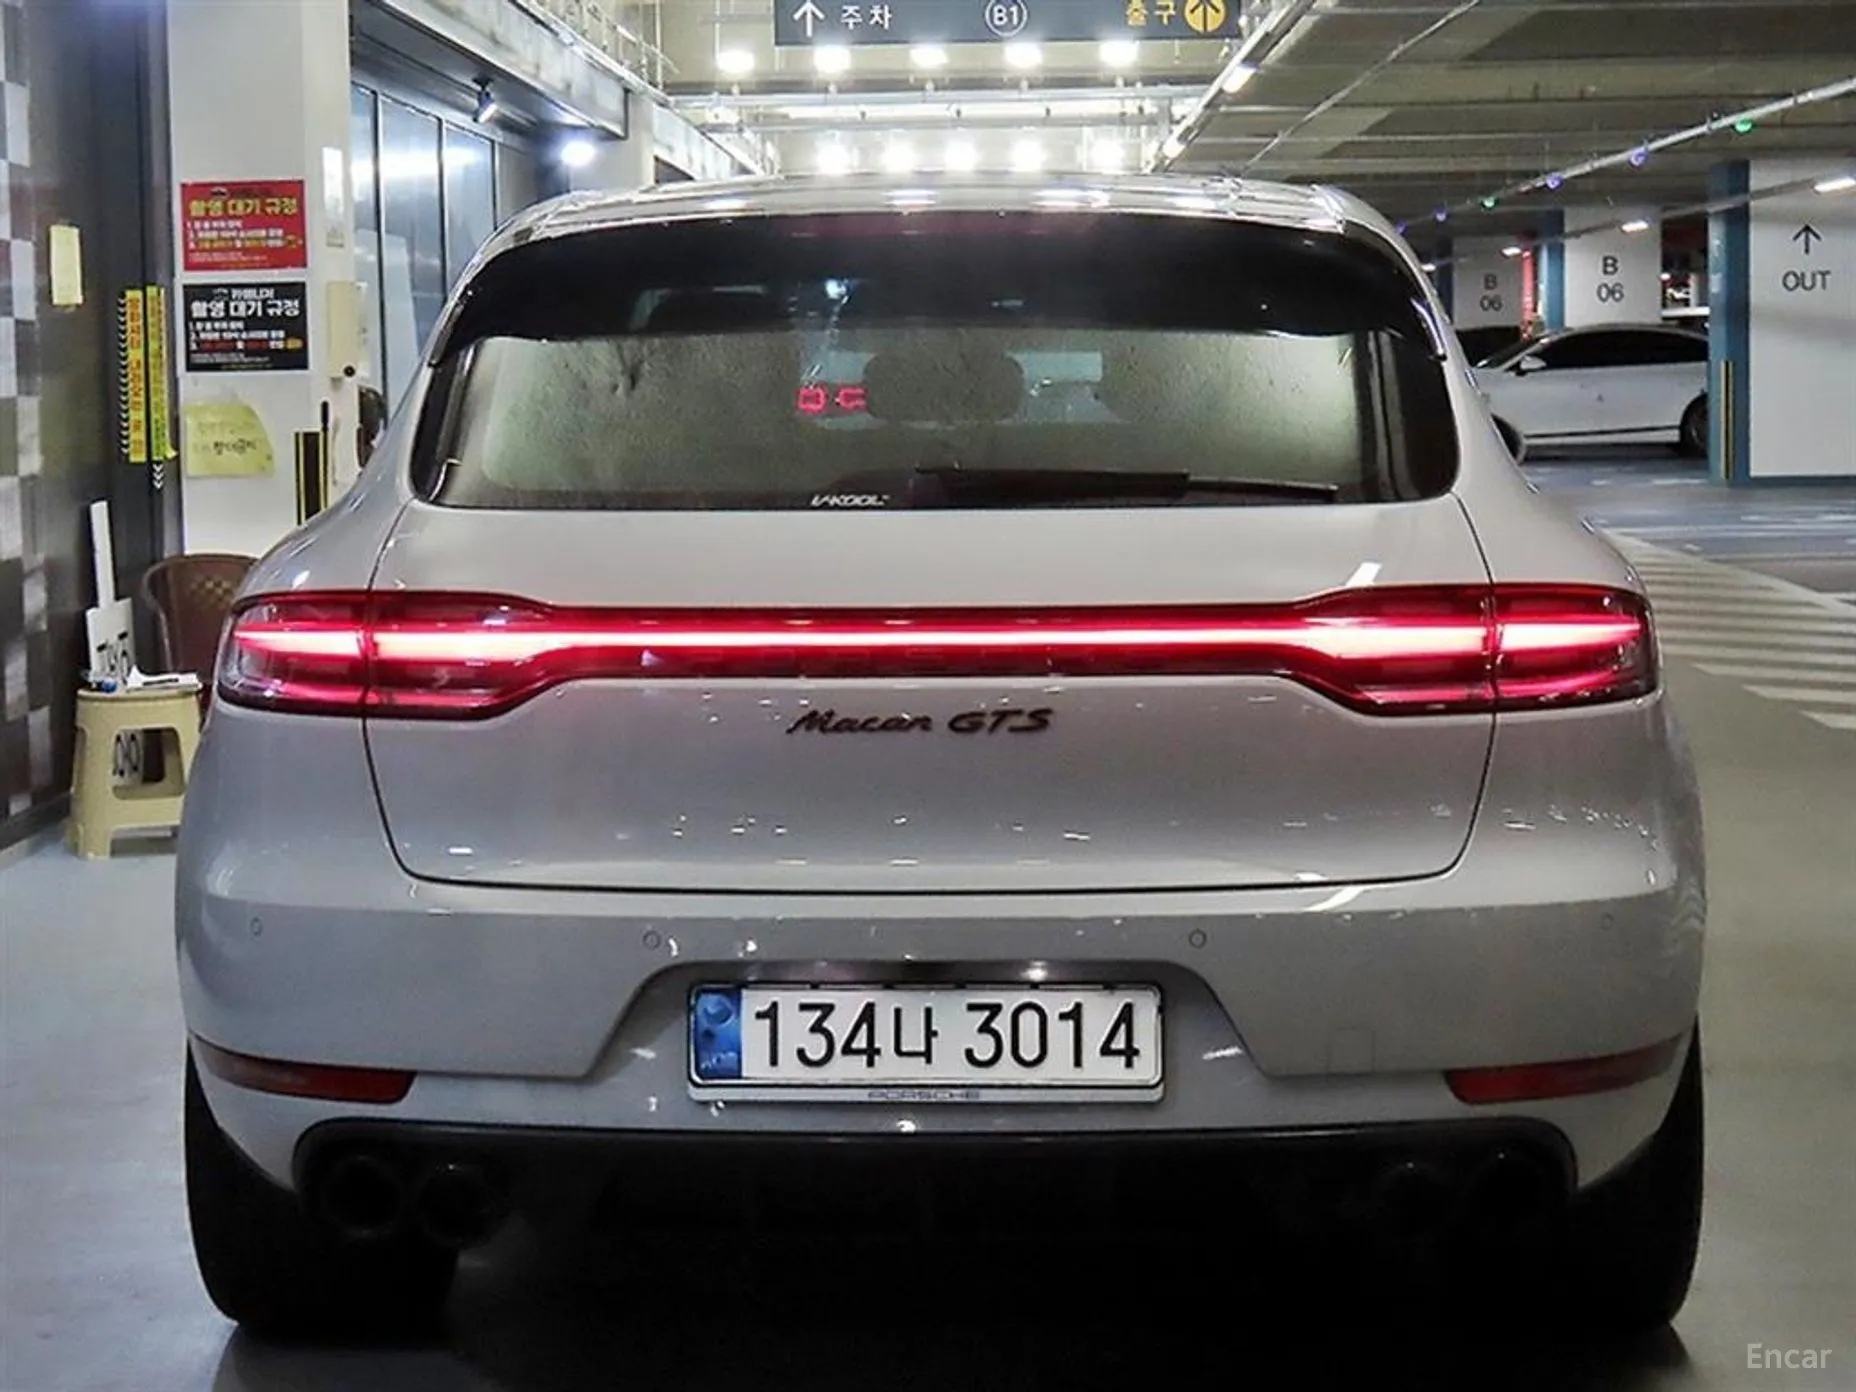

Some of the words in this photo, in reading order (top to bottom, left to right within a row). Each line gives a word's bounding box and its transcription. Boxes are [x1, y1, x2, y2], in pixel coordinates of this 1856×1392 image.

[841, 4, 893, 30] 주차
[993, 4, 1018, 26] B1
[1601, 255, 1619, 276] B
[1483, 273, 1498, 291] B
[1781, 270, 1832, 293] OUT
[1479, 296, 1502, 313] 06
[1596, 285, 1625, 304] 06
[229, 300, 263, 318] 대기
[266, 299, 300, 317] 규정
[785, 709, 933, 735] Macan
[947, 708, 1053, 735] GTS
[754, 1000, 939, 1069] 134나
[963, 1000, 1141, 1069] 3014
